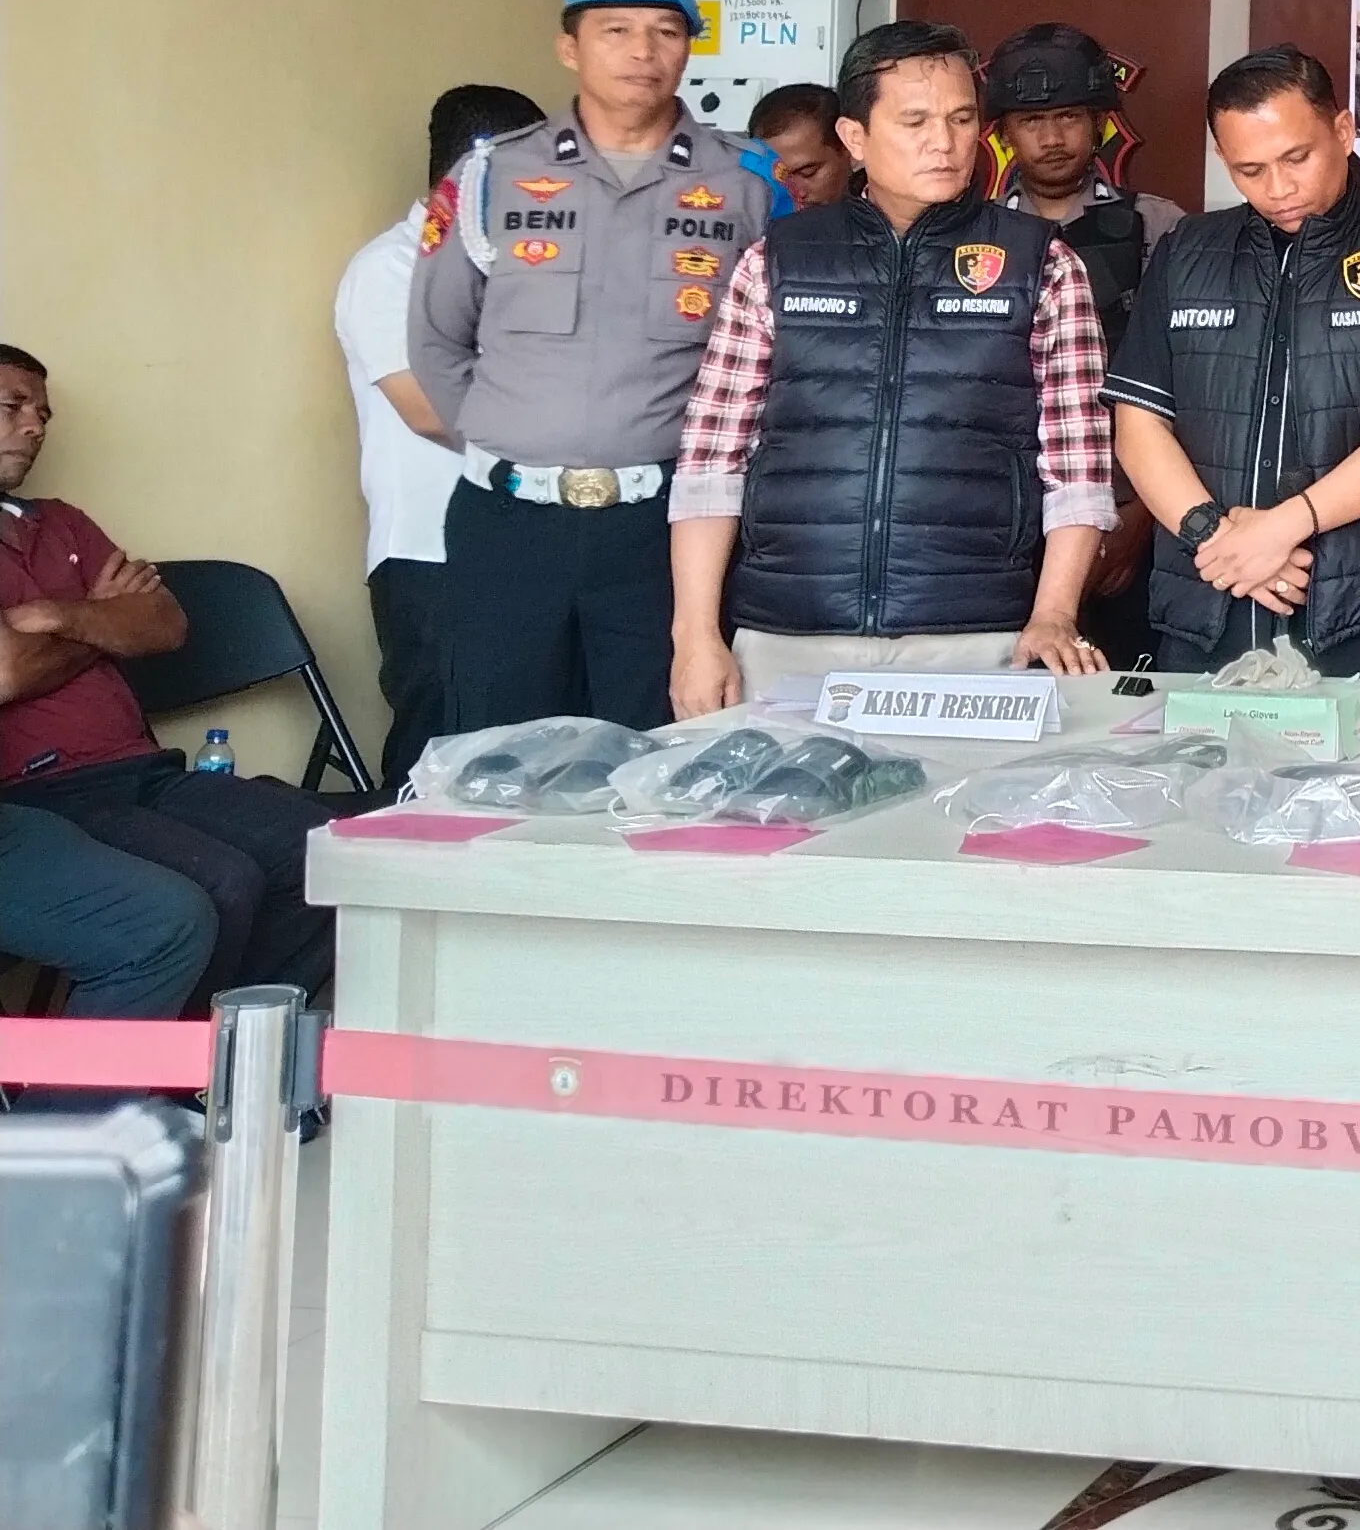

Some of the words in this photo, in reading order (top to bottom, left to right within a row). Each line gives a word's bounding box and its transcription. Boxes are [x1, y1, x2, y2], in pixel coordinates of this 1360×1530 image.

[740, 22, 797, 45] PLN
[504, 209, 577, 231] BENI
[664, 217, 734, 241] POLRI
[783, 296, 846, 314] DARMONO
[847, 300, 857, 314] S
[936, 298, 960, 313] KBO
[962, 298, 1010, 314] RESKRIM
[861, 690, 936, 718] KASAT
[937, 693, 1041, 721] RESKRIM
[1249, 709, 1279, 721] Gloves
[660, 1072, 1068, 1132] DIREKTORAT
